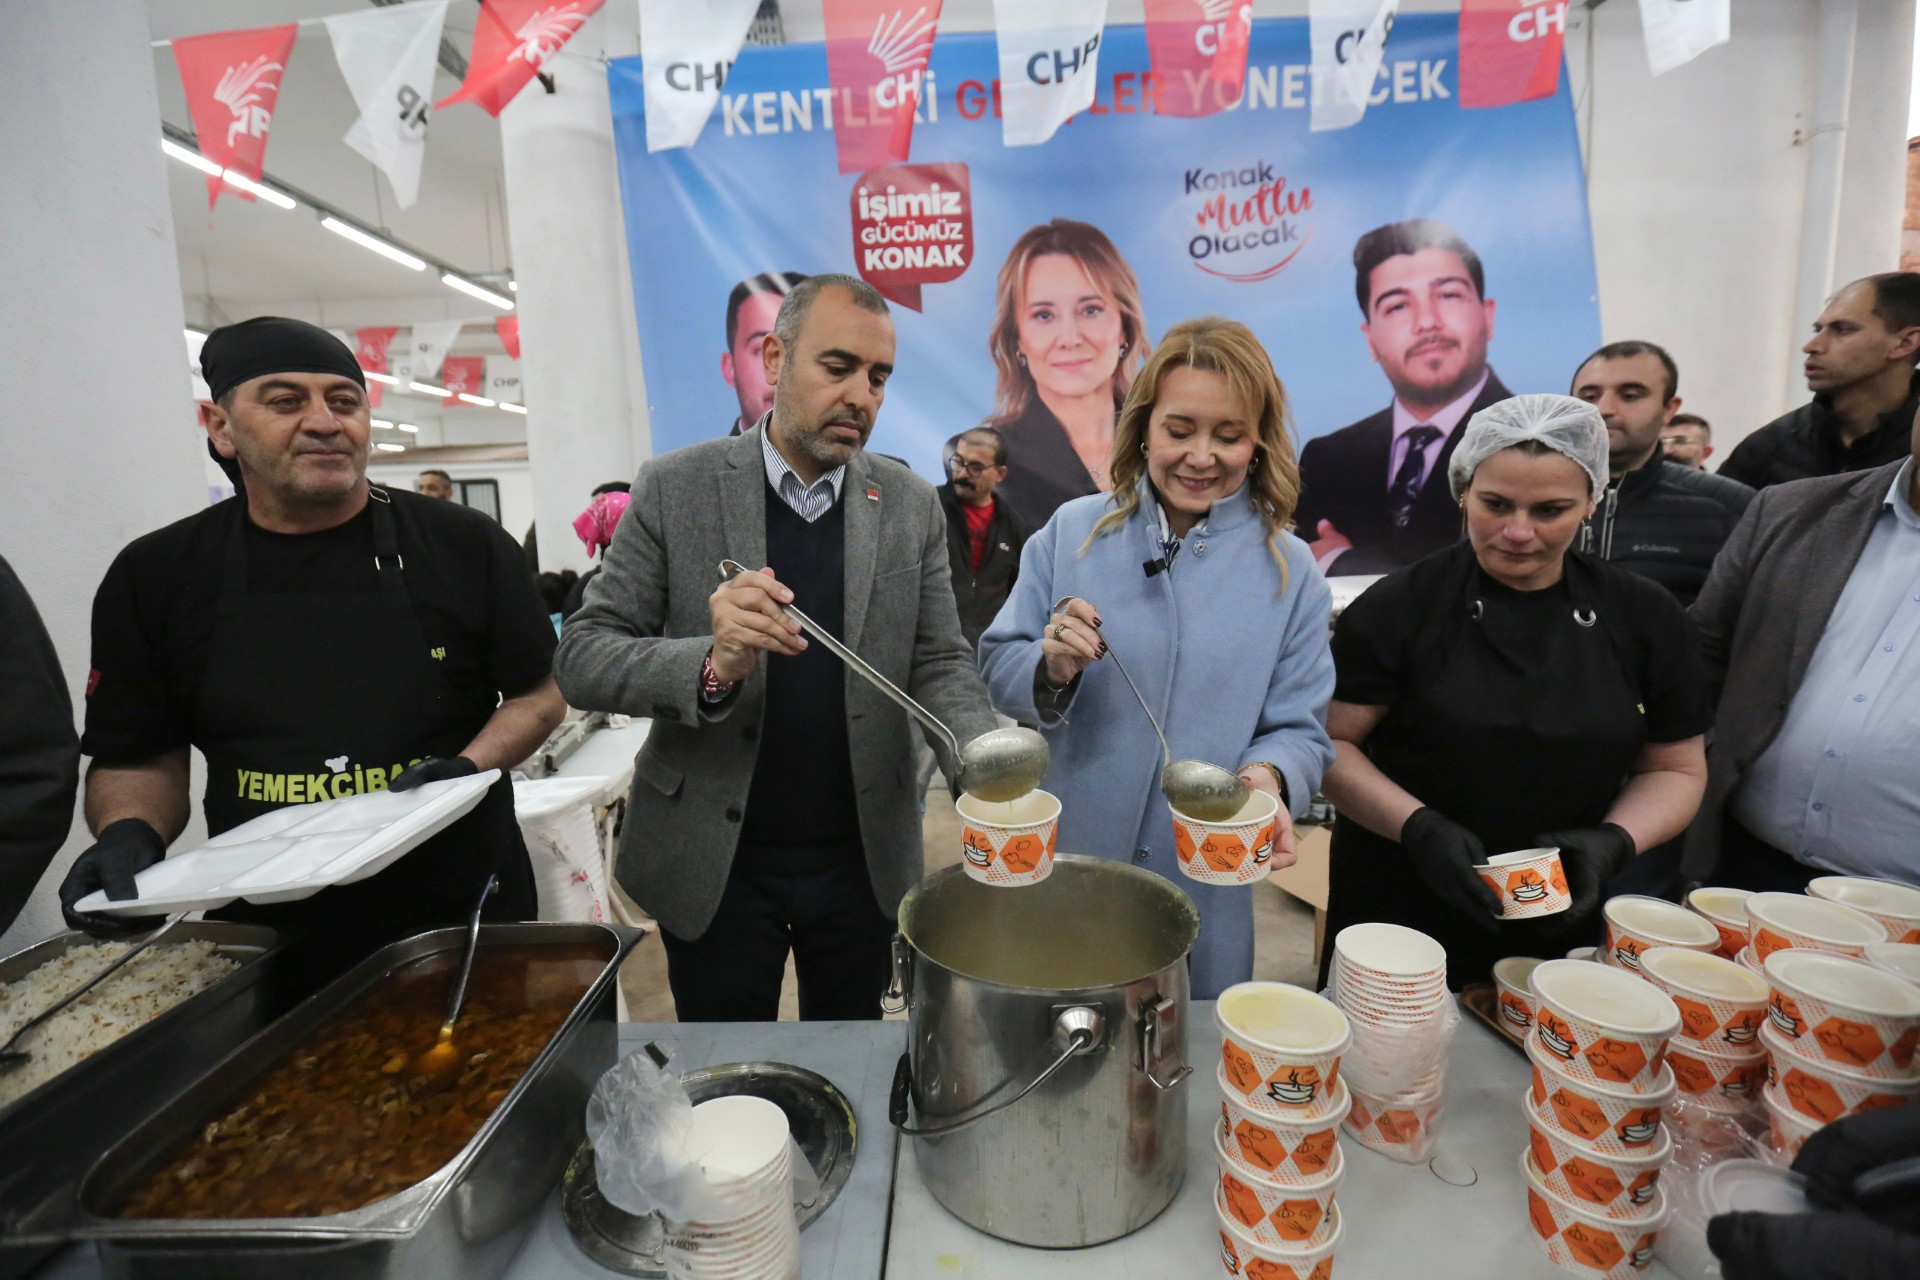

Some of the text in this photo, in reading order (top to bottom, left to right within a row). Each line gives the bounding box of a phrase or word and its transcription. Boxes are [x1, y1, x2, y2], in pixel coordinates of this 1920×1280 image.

[1508, 2, 1568, 42] CH
[665, 61, 733, 92] CH
[1026, 32, 1099, 85] CHP
[875, 69, 925, 108] CH
[1185, 159, 1274, 194] Konak
[1197, 176, 1313, 233] Mutlu
[860, 218, 964, 245] GÜCÜMÜZ
[1189, 220, 1299, 259] Olacak
[864, 243, 966, 271] KONAK
